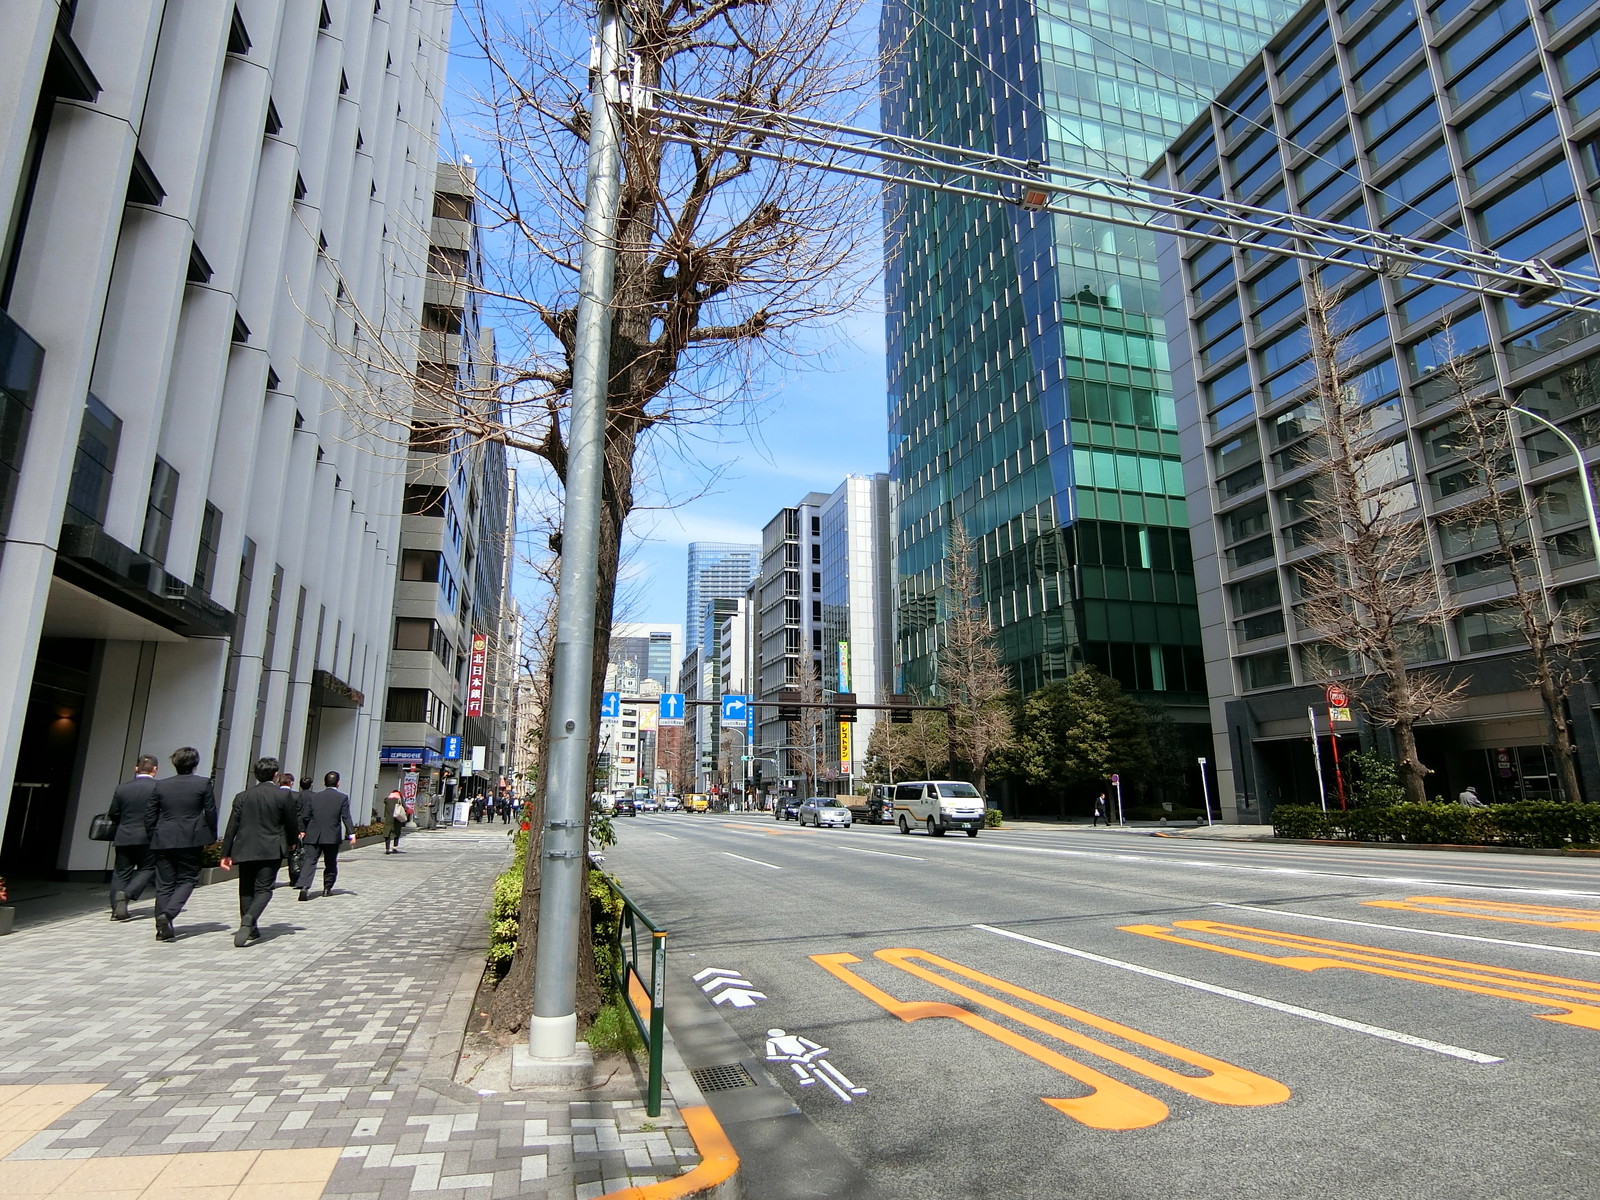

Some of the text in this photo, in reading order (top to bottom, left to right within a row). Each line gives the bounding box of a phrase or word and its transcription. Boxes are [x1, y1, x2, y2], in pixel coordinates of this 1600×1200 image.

[469, 653, 484, 711] 北日本銀行
[448, 737, 457, 758] おそば
[841, 727, 849, 758] レストラン
[809, 948, 1292, 1131] 50
